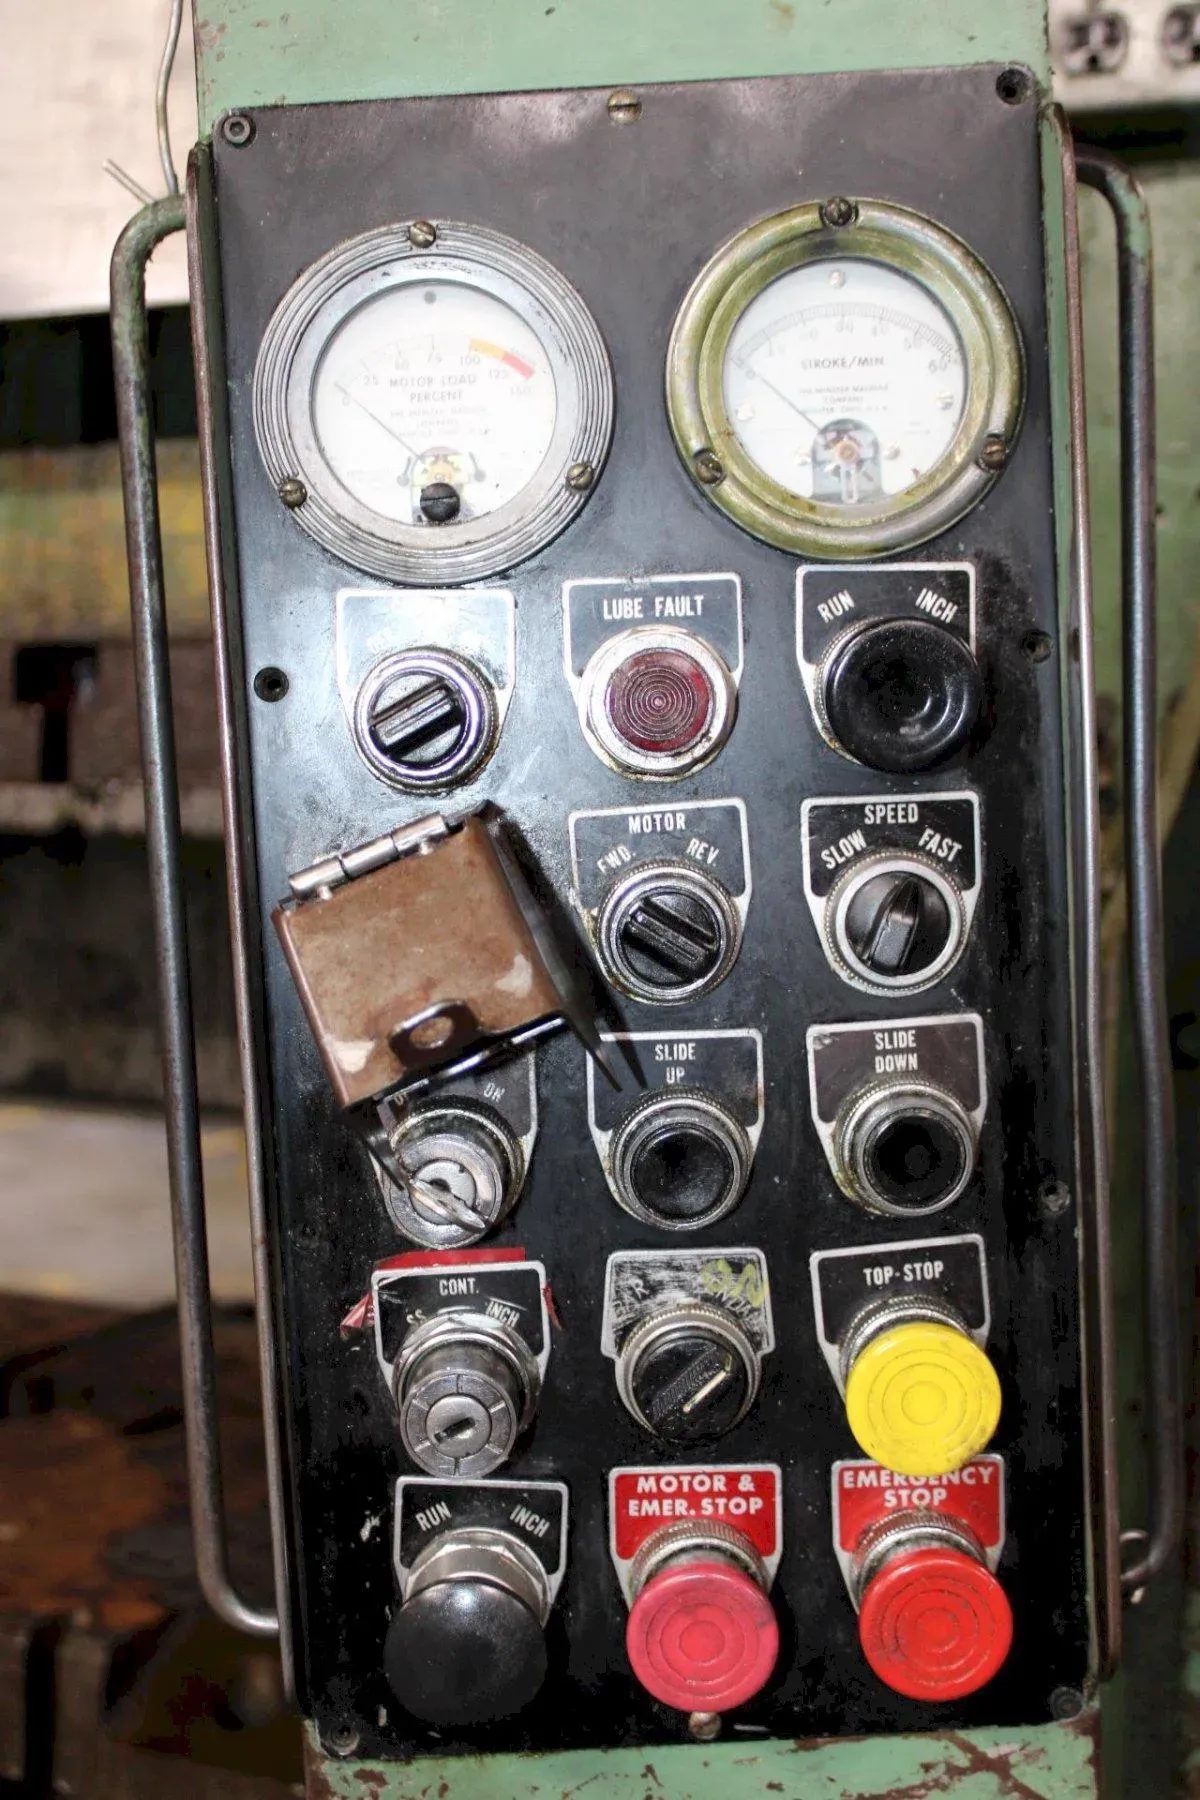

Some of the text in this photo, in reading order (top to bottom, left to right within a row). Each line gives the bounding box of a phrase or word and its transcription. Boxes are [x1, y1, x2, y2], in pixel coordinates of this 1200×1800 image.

[460, 355, 481, 367] 100
[801, 355, 884, 371] STROKE/MIN
[929, 358, 948, 373] 60
[390, 374, 477, 389] MOTOR LOAD
[410, 390, 464, 403] PERCENT
[603, 595, 704, 620] LUBE FAULT
[817, 590, 855, 624] RUN
[915, 588, 959, 624] INCH
[628, 813, 686, 835] MOTOR
[864, 803, 919, 825] SPEED
[685, 837, 720, 867] REV.
[820, 829, 868, 870] SLOW
[917, 827, 963, 862] FAST
[596, 844, 637, 874] FWD.
[874, 1029, 917, 1051] SLIDE
[654, 1042, 697, 1062] SLIDE
[875, 1053, 918, 1074] DOWN
[665, 1066, 686, 1084] UP
[483, 1082, 506, 1104] ON
[438, 1277, 480, 1297] CONT.
[485, 1299, 521, 1328] INCH
[636, 1473, 756, 1494] MOTOR &
[628, 1496, 764, 1517] EMER. STOP
[883, 1487, 948, 1508] STOP
[415, 1501, 452, 1532] RUN
[509, 1503, 550, 1538] INCH
